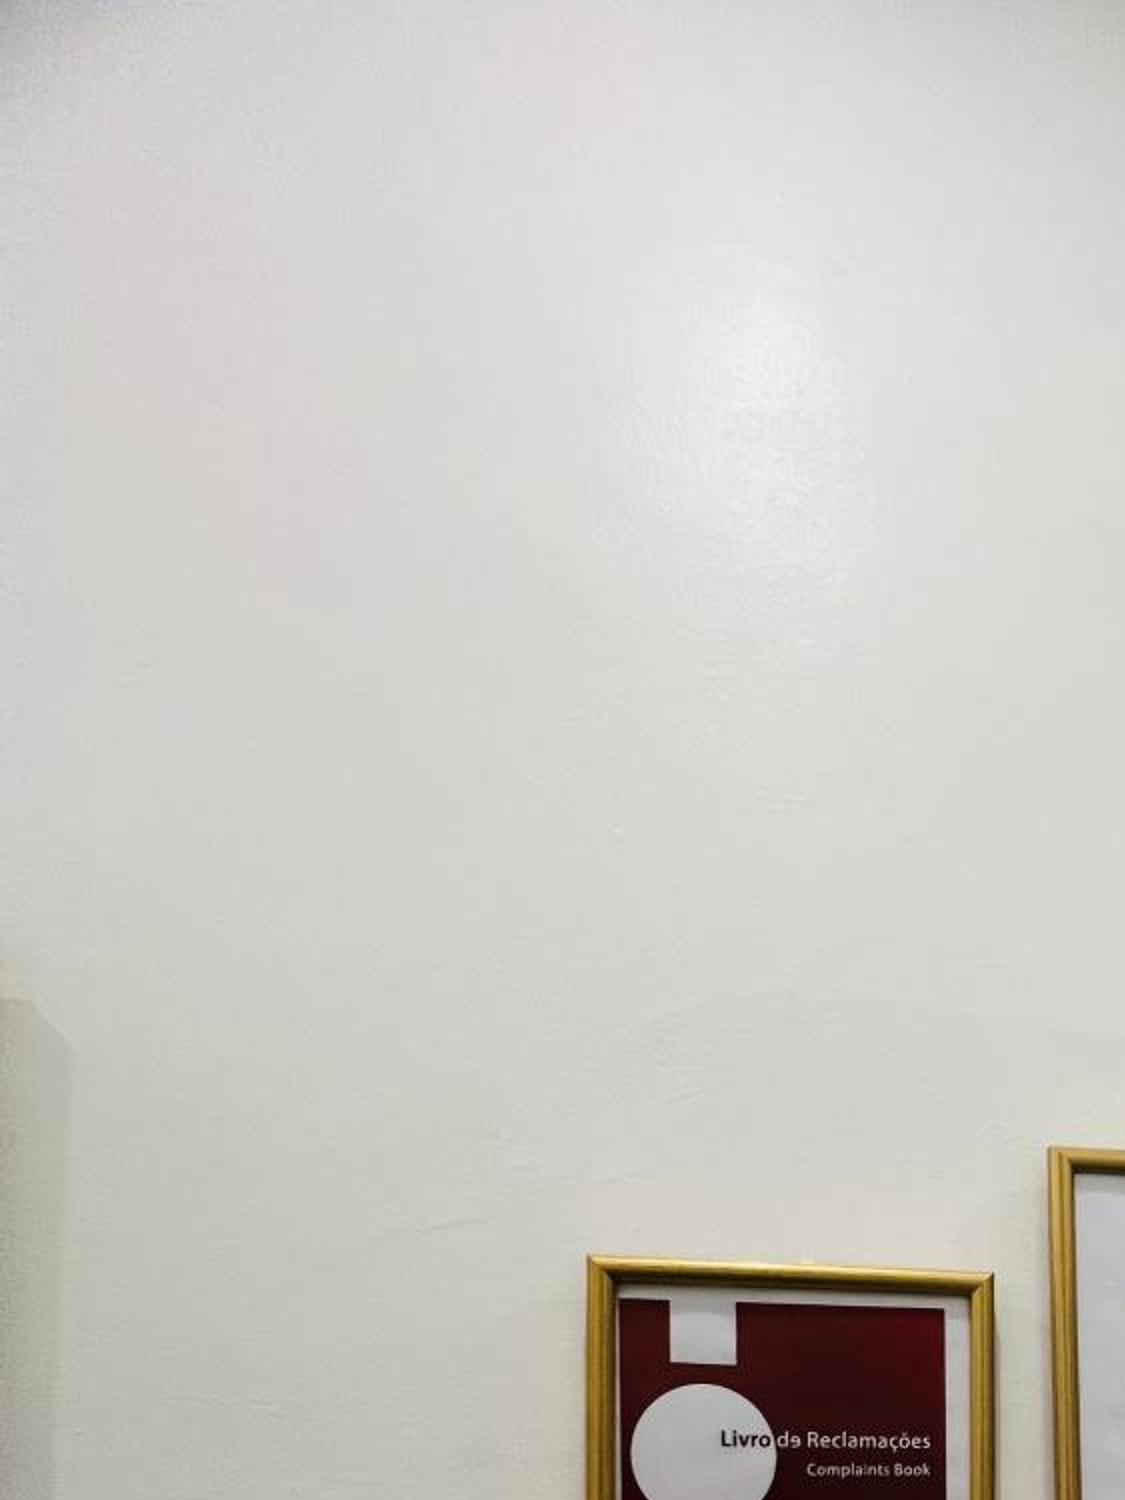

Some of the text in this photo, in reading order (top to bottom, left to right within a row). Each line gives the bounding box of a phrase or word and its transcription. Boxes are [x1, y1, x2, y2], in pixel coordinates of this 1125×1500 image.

[721, 1429, 931, 1454] Livro de Reclamações
[806, 1461, 931, 1480] Complaints Book
